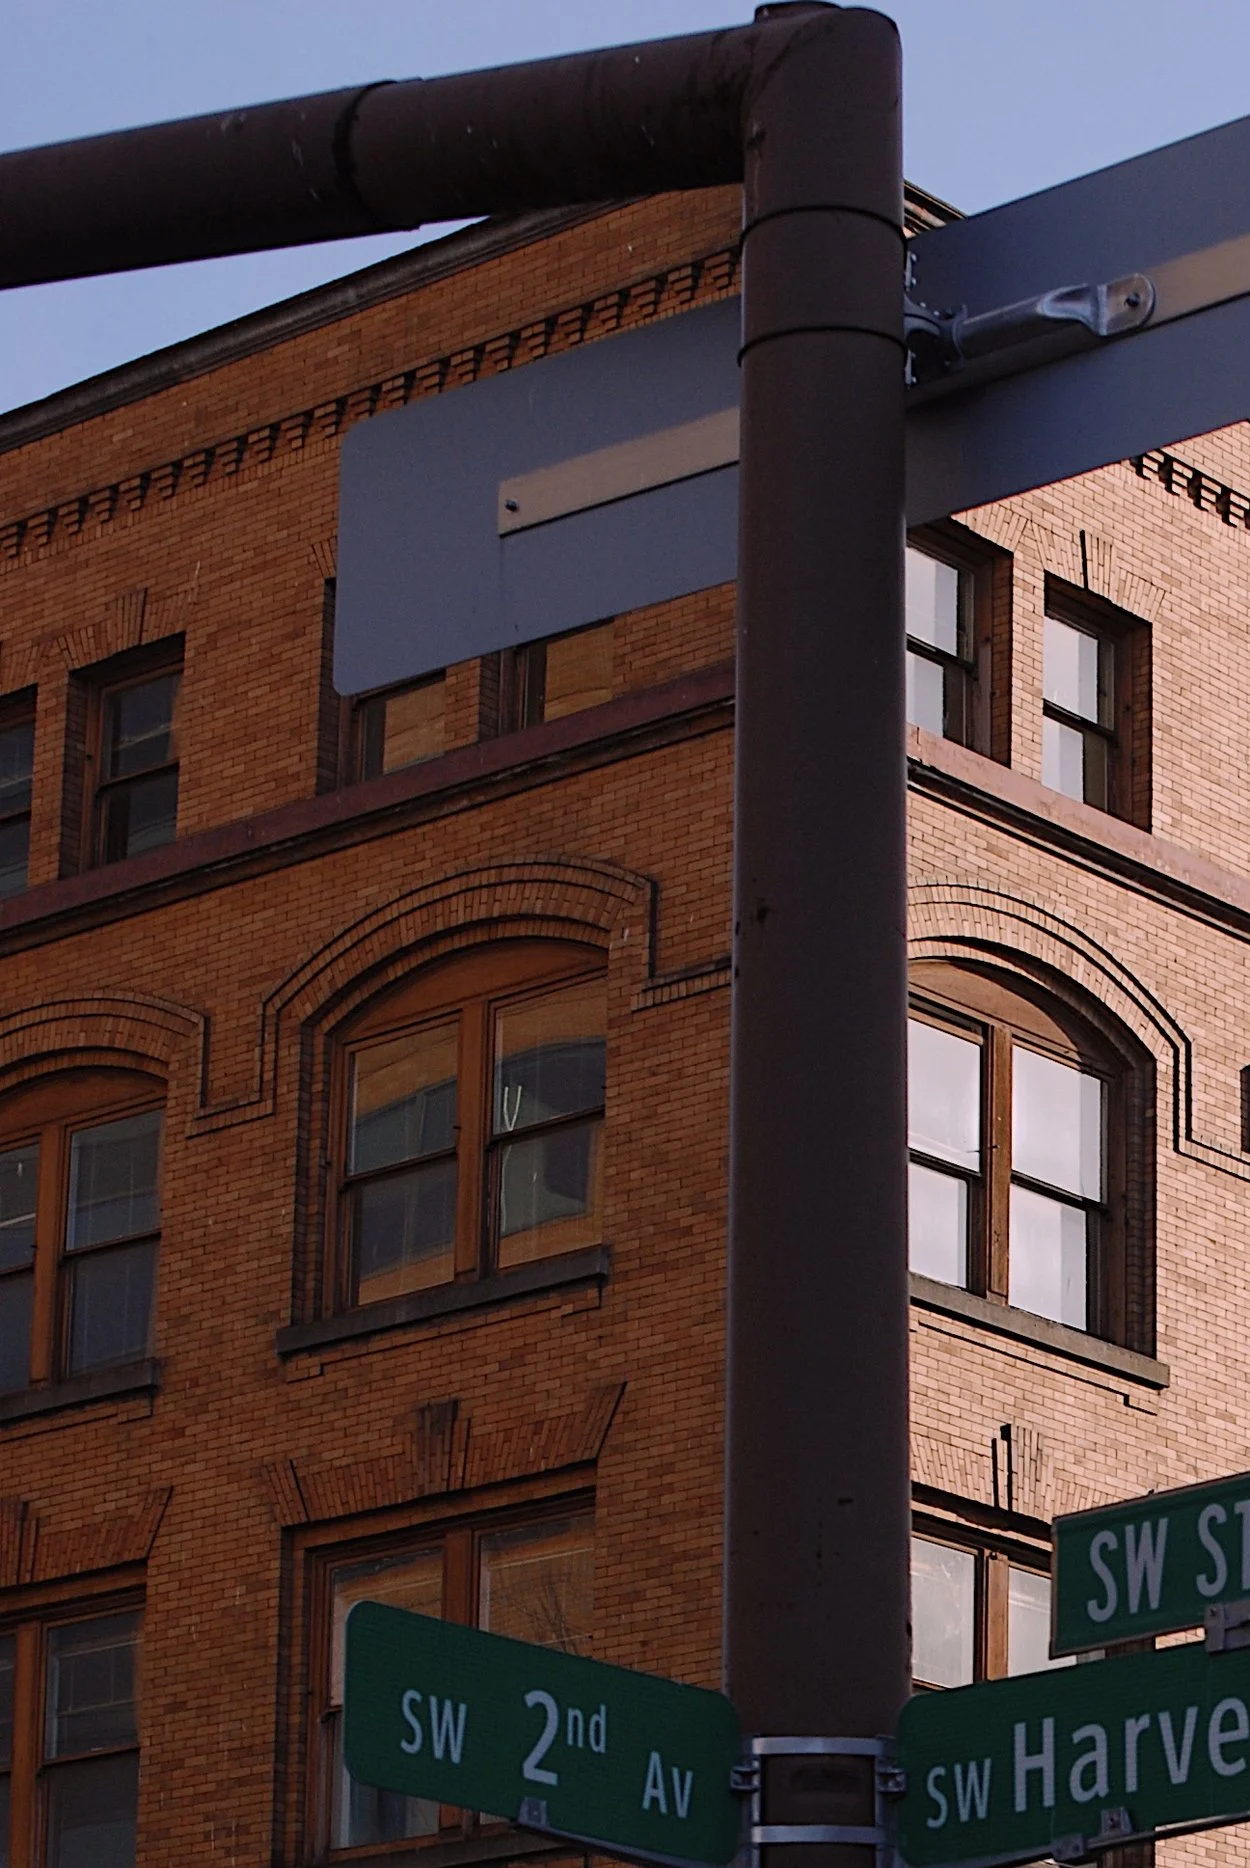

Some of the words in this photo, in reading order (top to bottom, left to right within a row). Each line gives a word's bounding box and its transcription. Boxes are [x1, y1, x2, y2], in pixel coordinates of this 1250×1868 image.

[1087, 1518, 1168, 1622] SW
[401, 1689, 467, 1764] SW
[522, 1689, 607, 1786] 2nd
[642, 1750, 693, 1819] Av
[926, 1757, 992, 1829] SW
